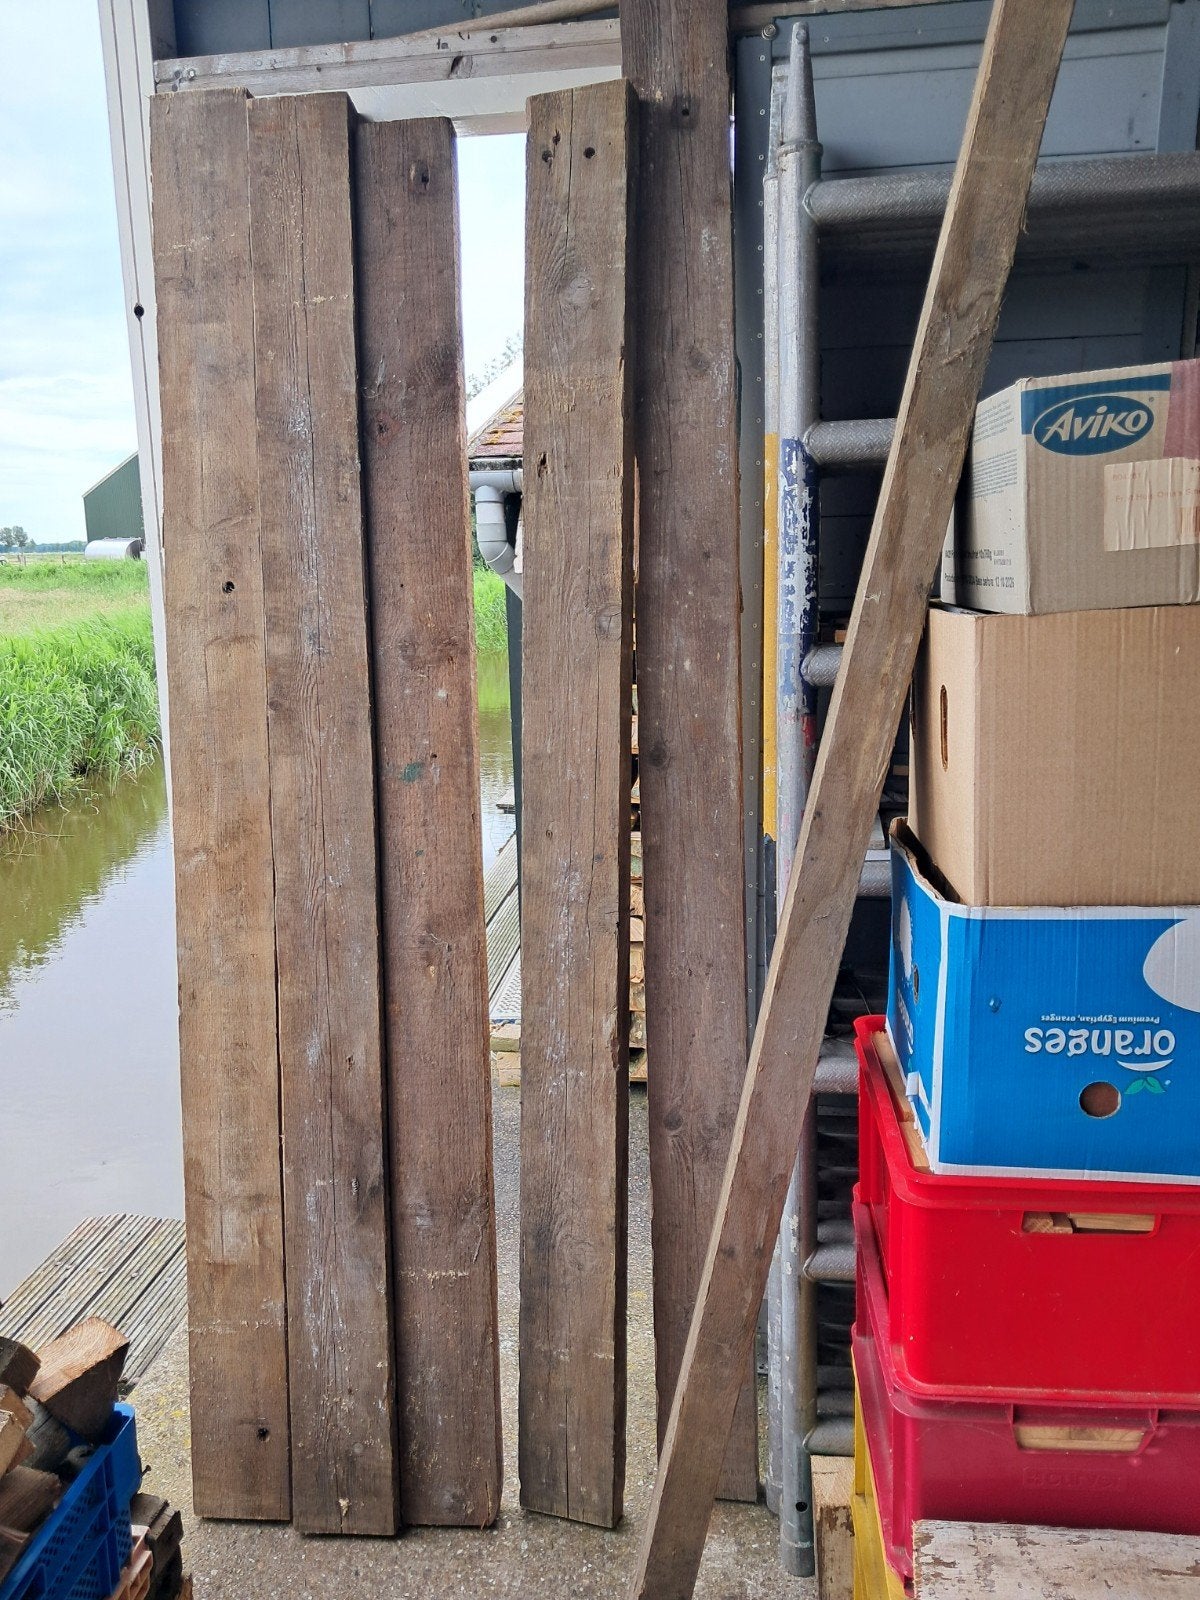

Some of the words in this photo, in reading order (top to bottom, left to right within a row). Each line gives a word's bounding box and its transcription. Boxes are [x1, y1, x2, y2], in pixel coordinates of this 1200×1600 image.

[1041, 405, 1149, 444] Aviko
[1041, 1013, 1076, 1023] oranges
[1118, 1015, 1160, 1025] Premium
[1024, 1027, 1176, 1058] oranges
